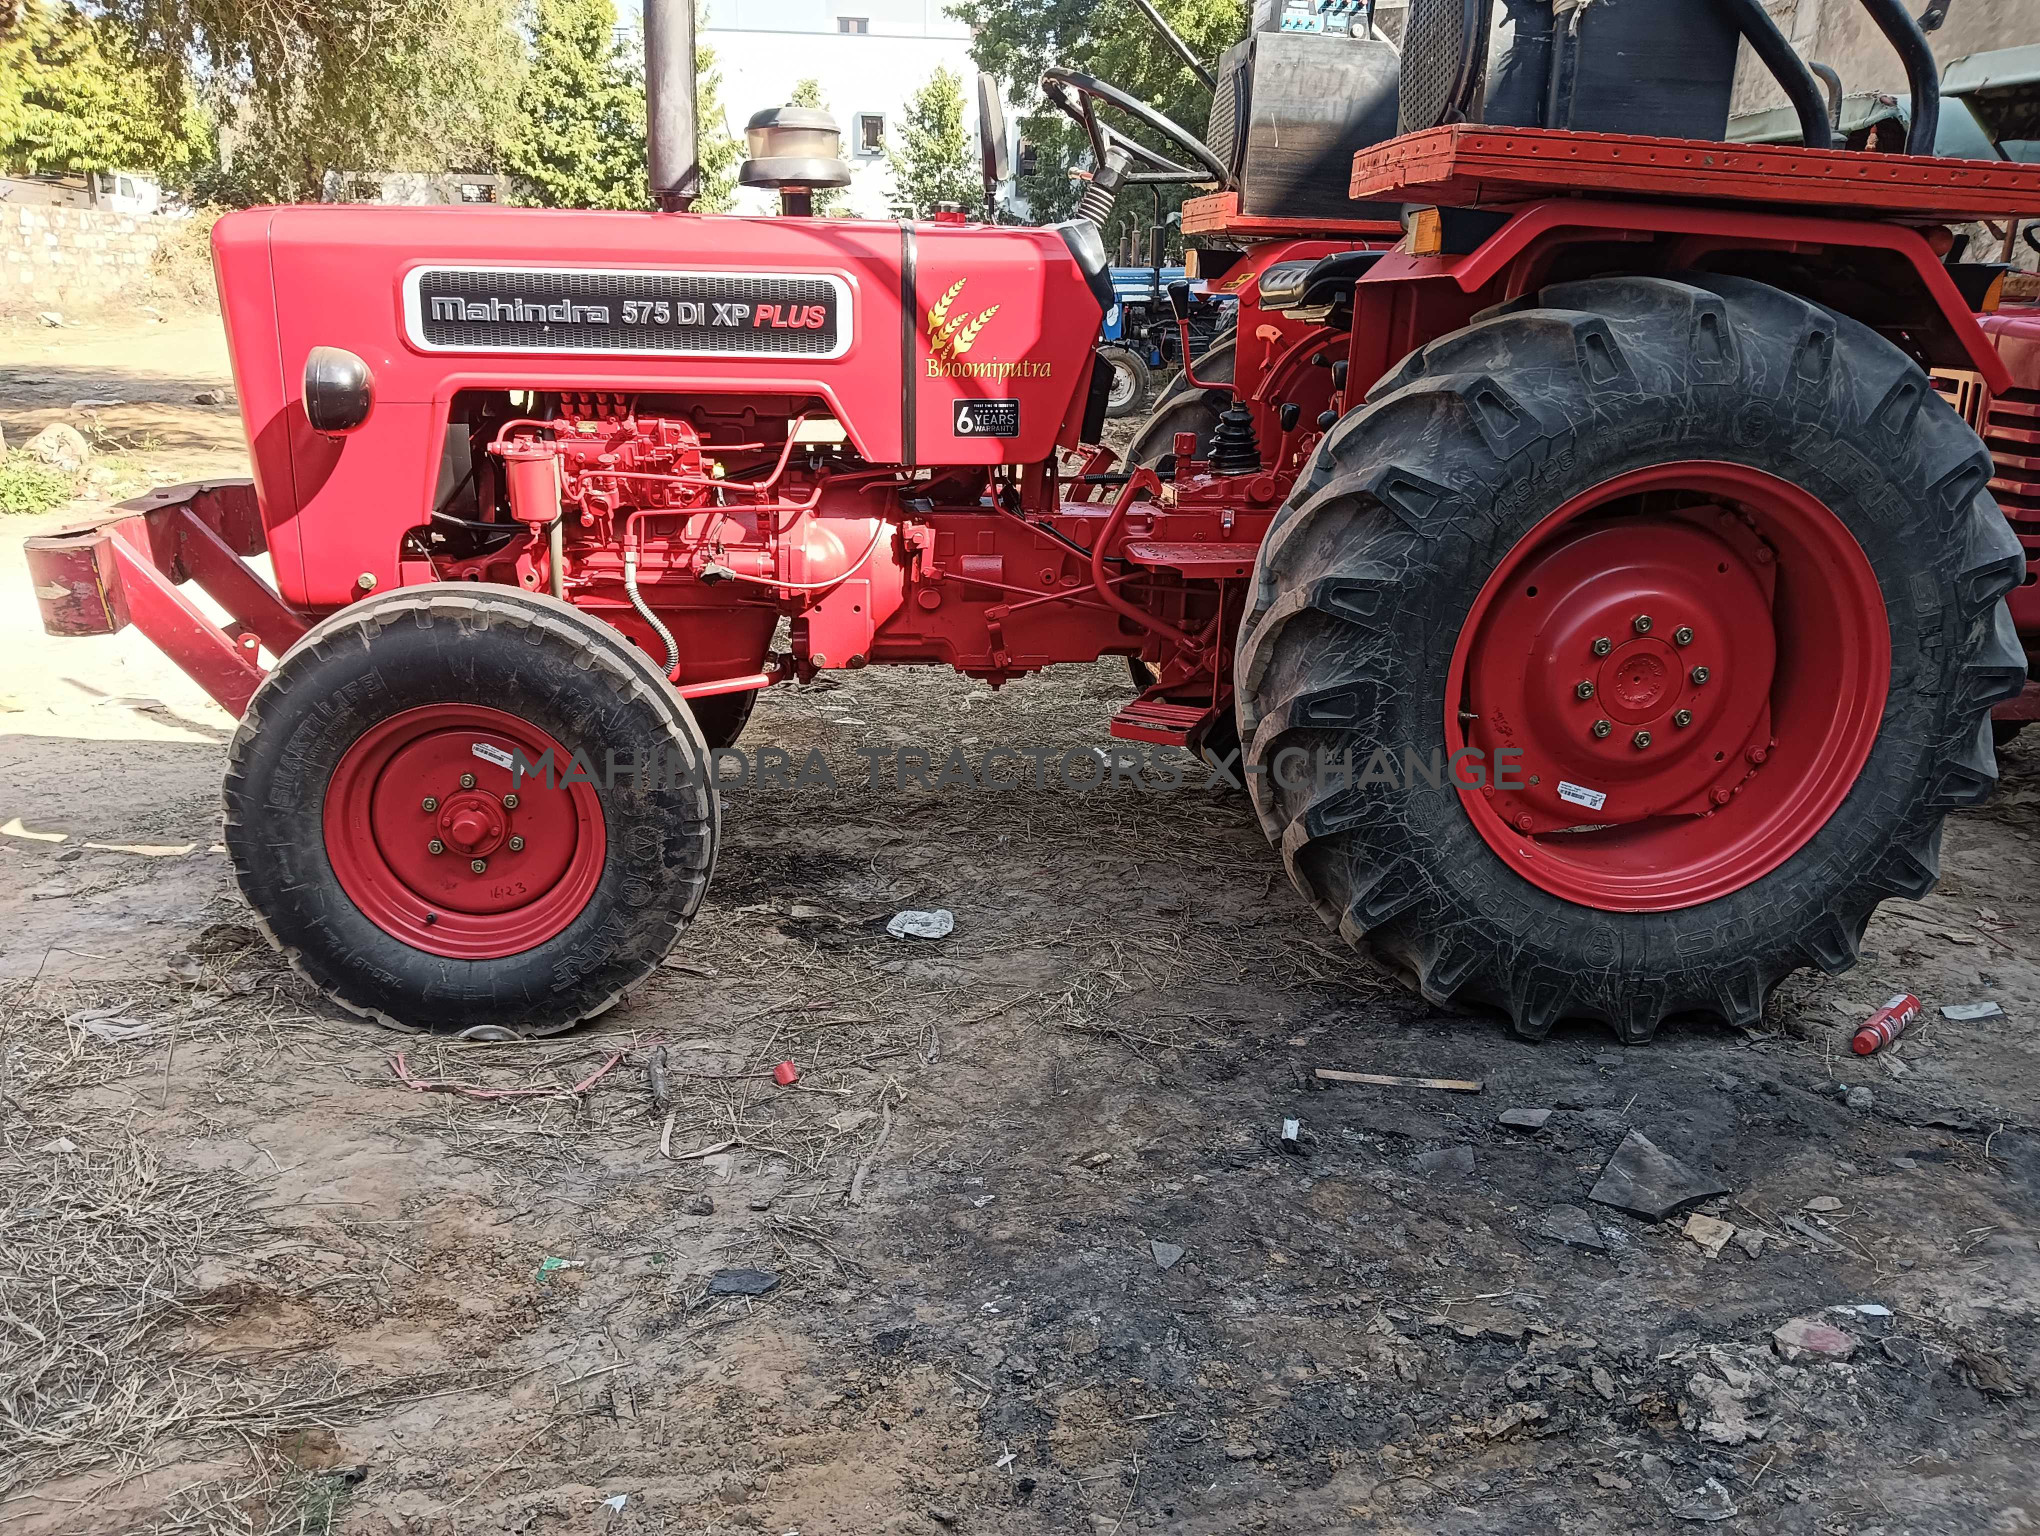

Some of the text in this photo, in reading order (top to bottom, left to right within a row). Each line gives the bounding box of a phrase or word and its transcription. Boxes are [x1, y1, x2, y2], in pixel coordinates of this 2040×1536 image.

[621, 301, 670, 325] 575
[677, 302, 705, 327] DI
[712, 303, 750, 328] XP
[752, 304, 826, 329] PLUS
[925, 356, 1052, 385] Bhoomiputra
[956, 406, 974, 433] 6
[269, 671, 382, 805] SHAKTI LIFE
[1443, 859, 1569, 952] MRF
[551, 906, 632, 995] MRF
